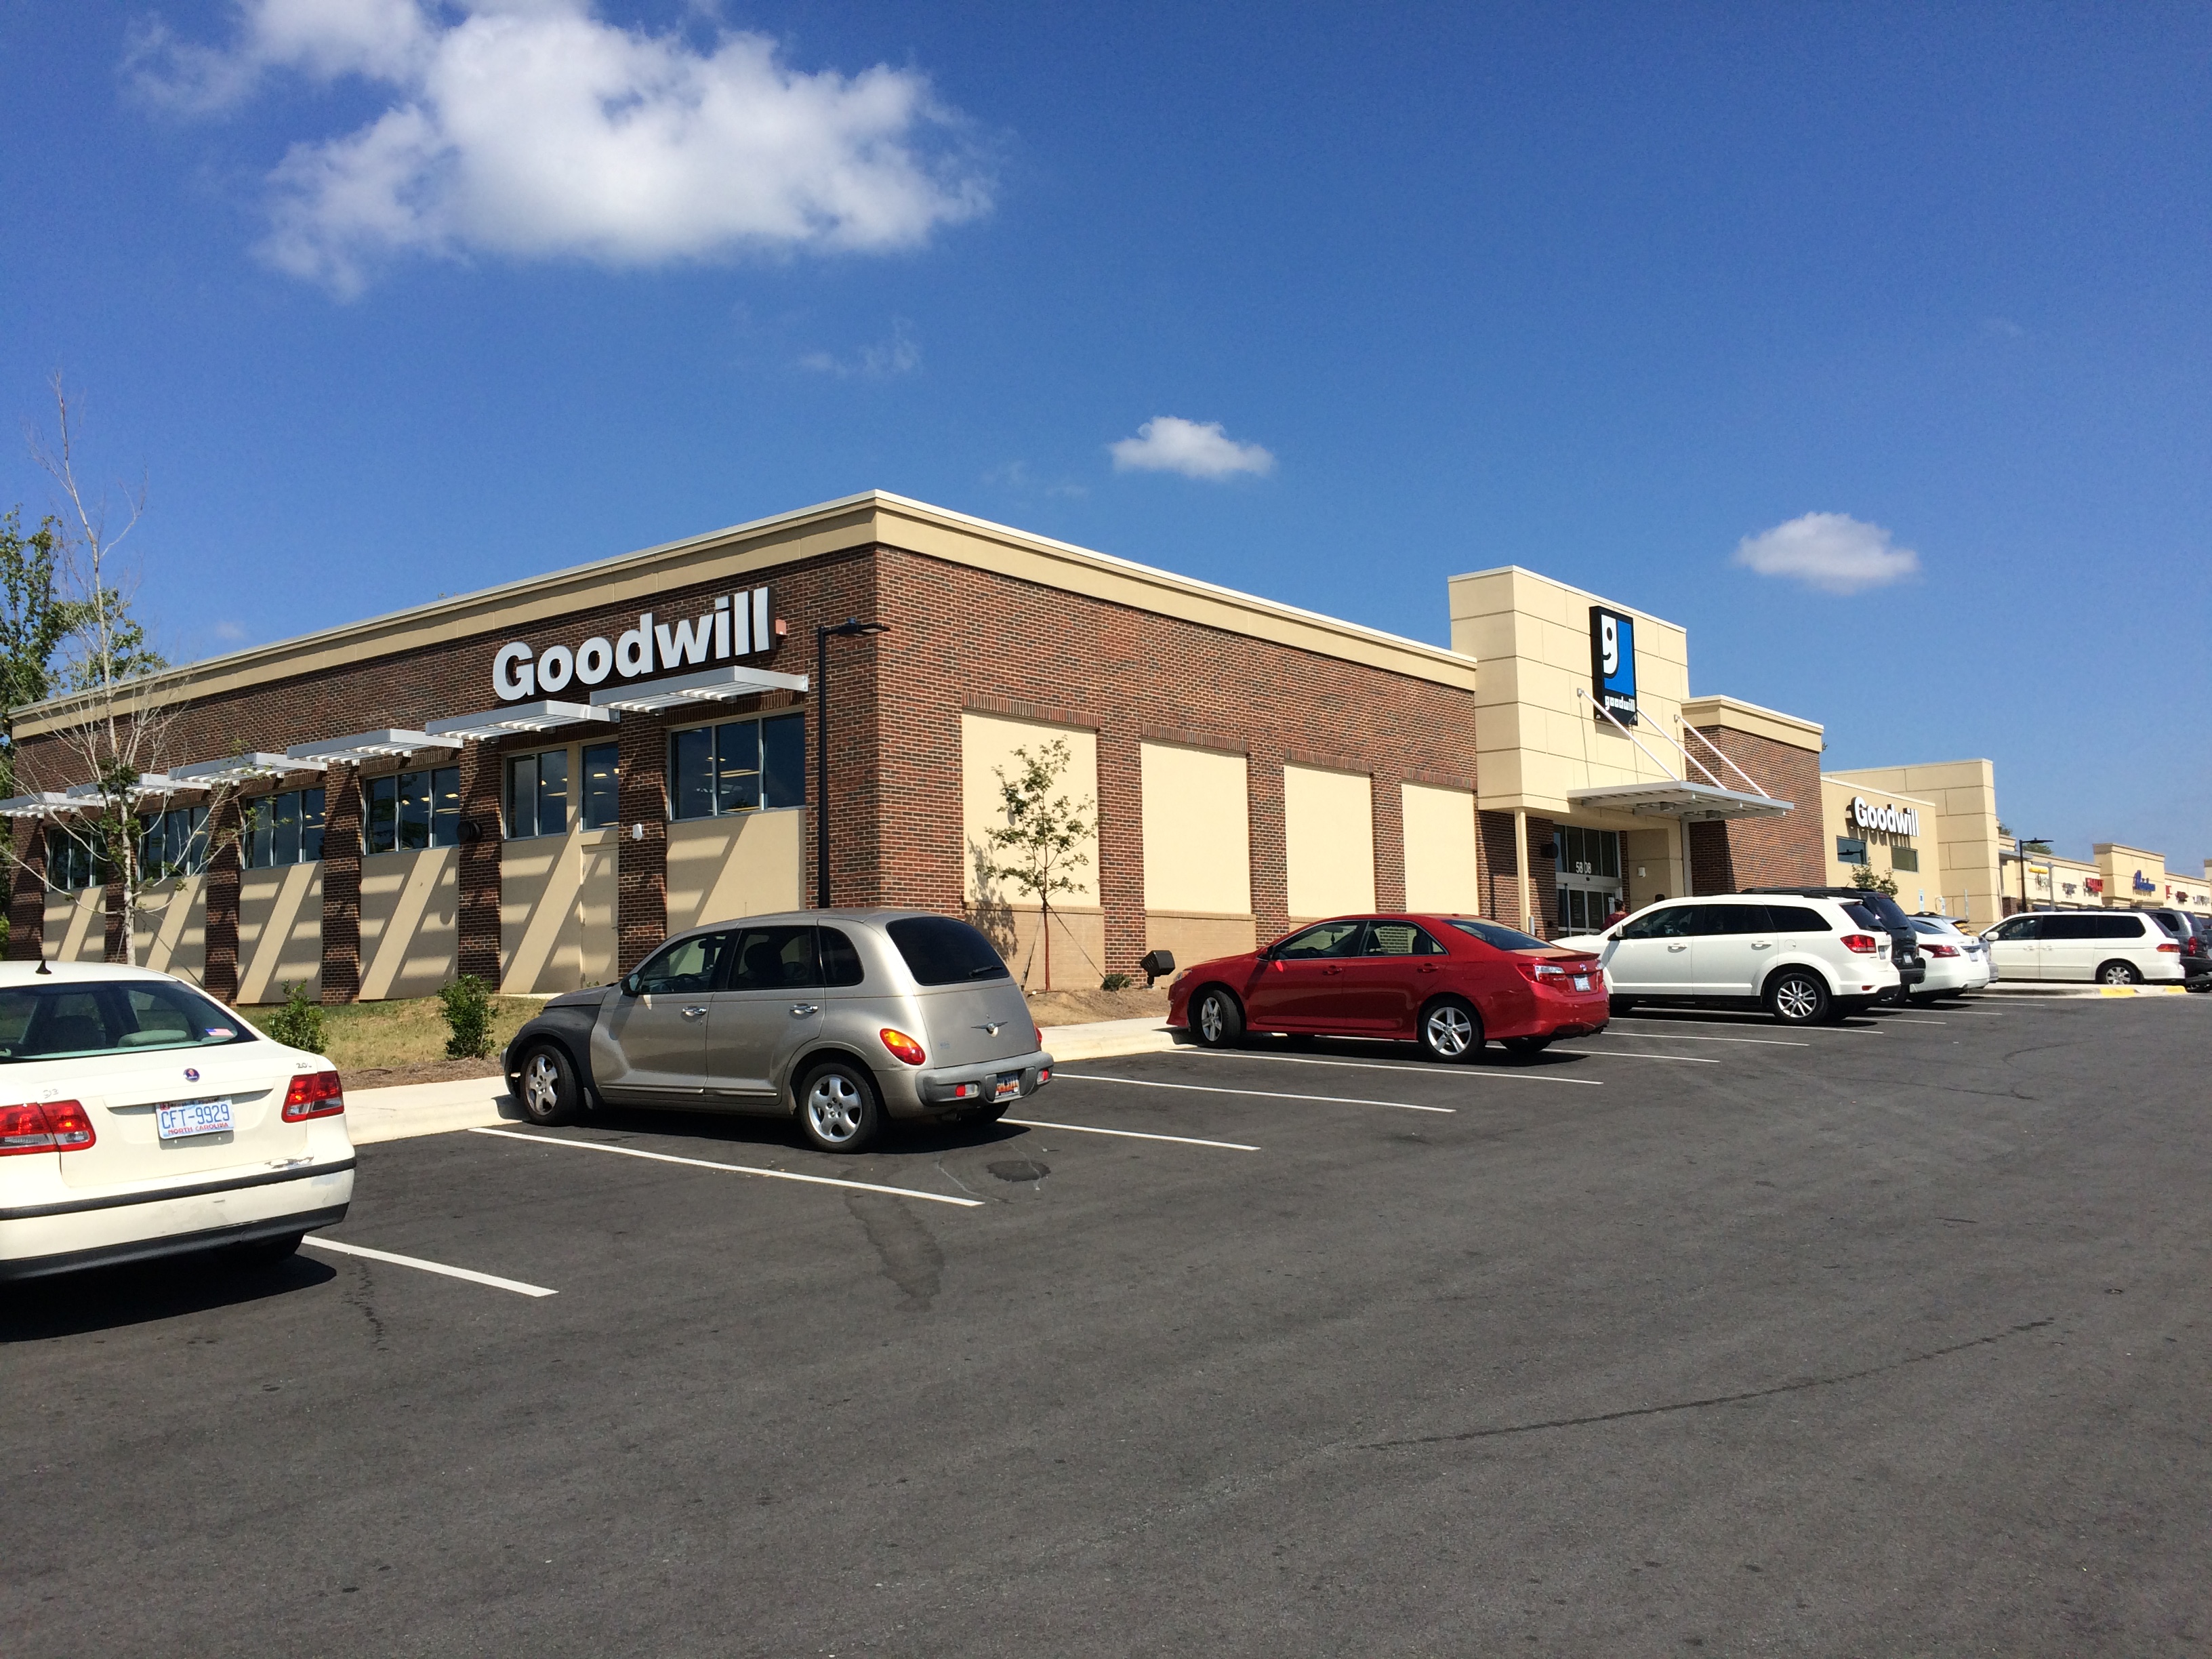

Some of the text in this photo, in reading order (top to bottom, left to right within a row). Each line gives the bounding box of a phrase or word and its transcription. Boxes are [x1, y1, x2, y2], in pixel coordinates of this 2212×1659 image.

[493, 586, 770, 701] Goodwill
[1604, 695, 1636, 712] goodwill
[1853, 796, 1920, 838] Goodwill
[1576, 861, 1592, 874] 5808
[161, 1103, 230, 1130] CFT-9929
[168, 1122, 229, 1135] NORTH CAROLINA
